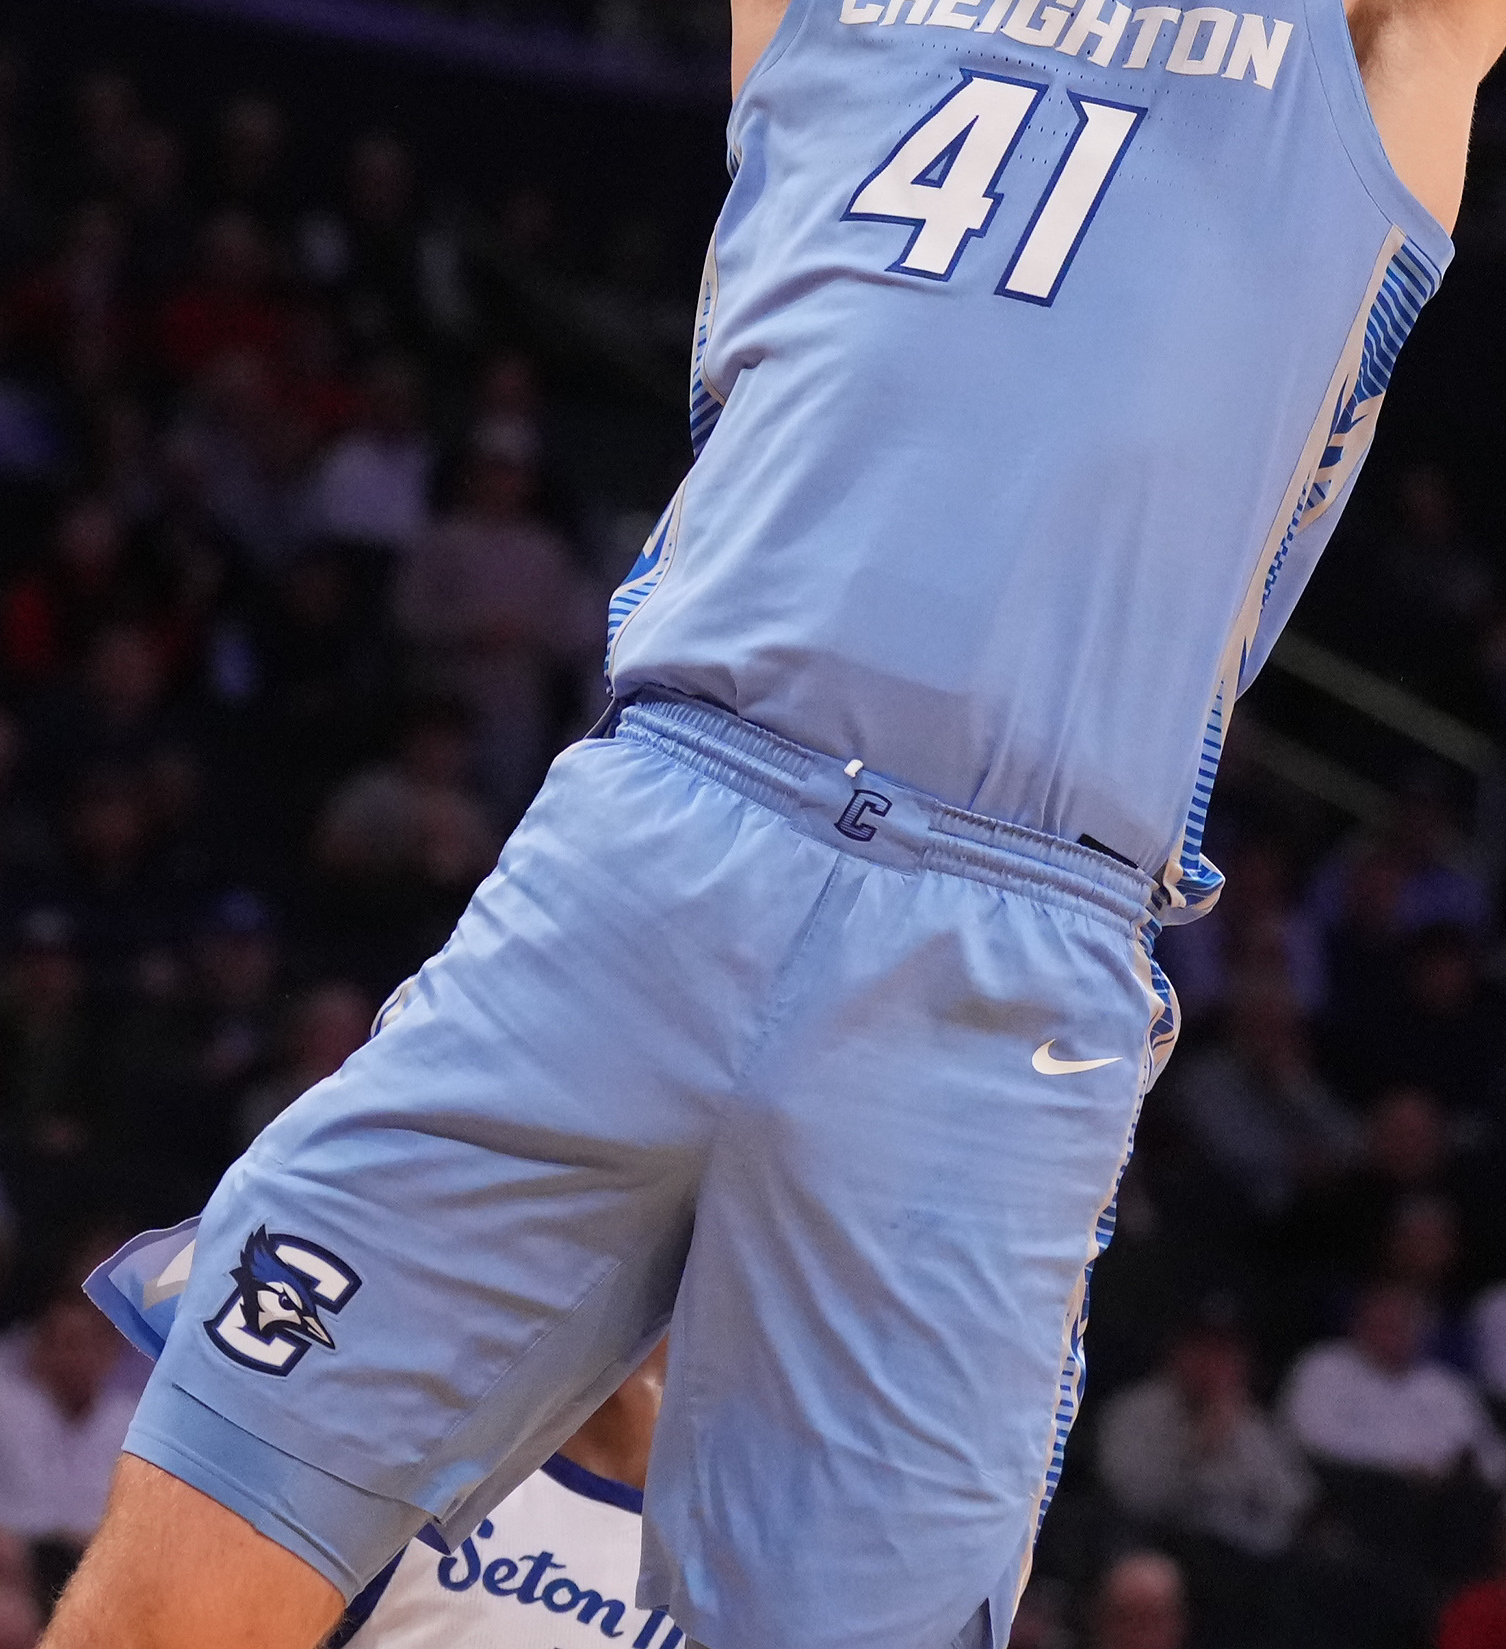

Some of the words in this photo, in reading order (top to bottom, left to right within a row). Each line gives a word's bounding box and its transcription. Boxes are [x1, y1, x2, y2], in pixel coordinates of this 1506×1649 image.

[839, 68, 1148, 307] 41
[834, 789, 892, 842] C
[437, 1519, 625, 1638] Seton
